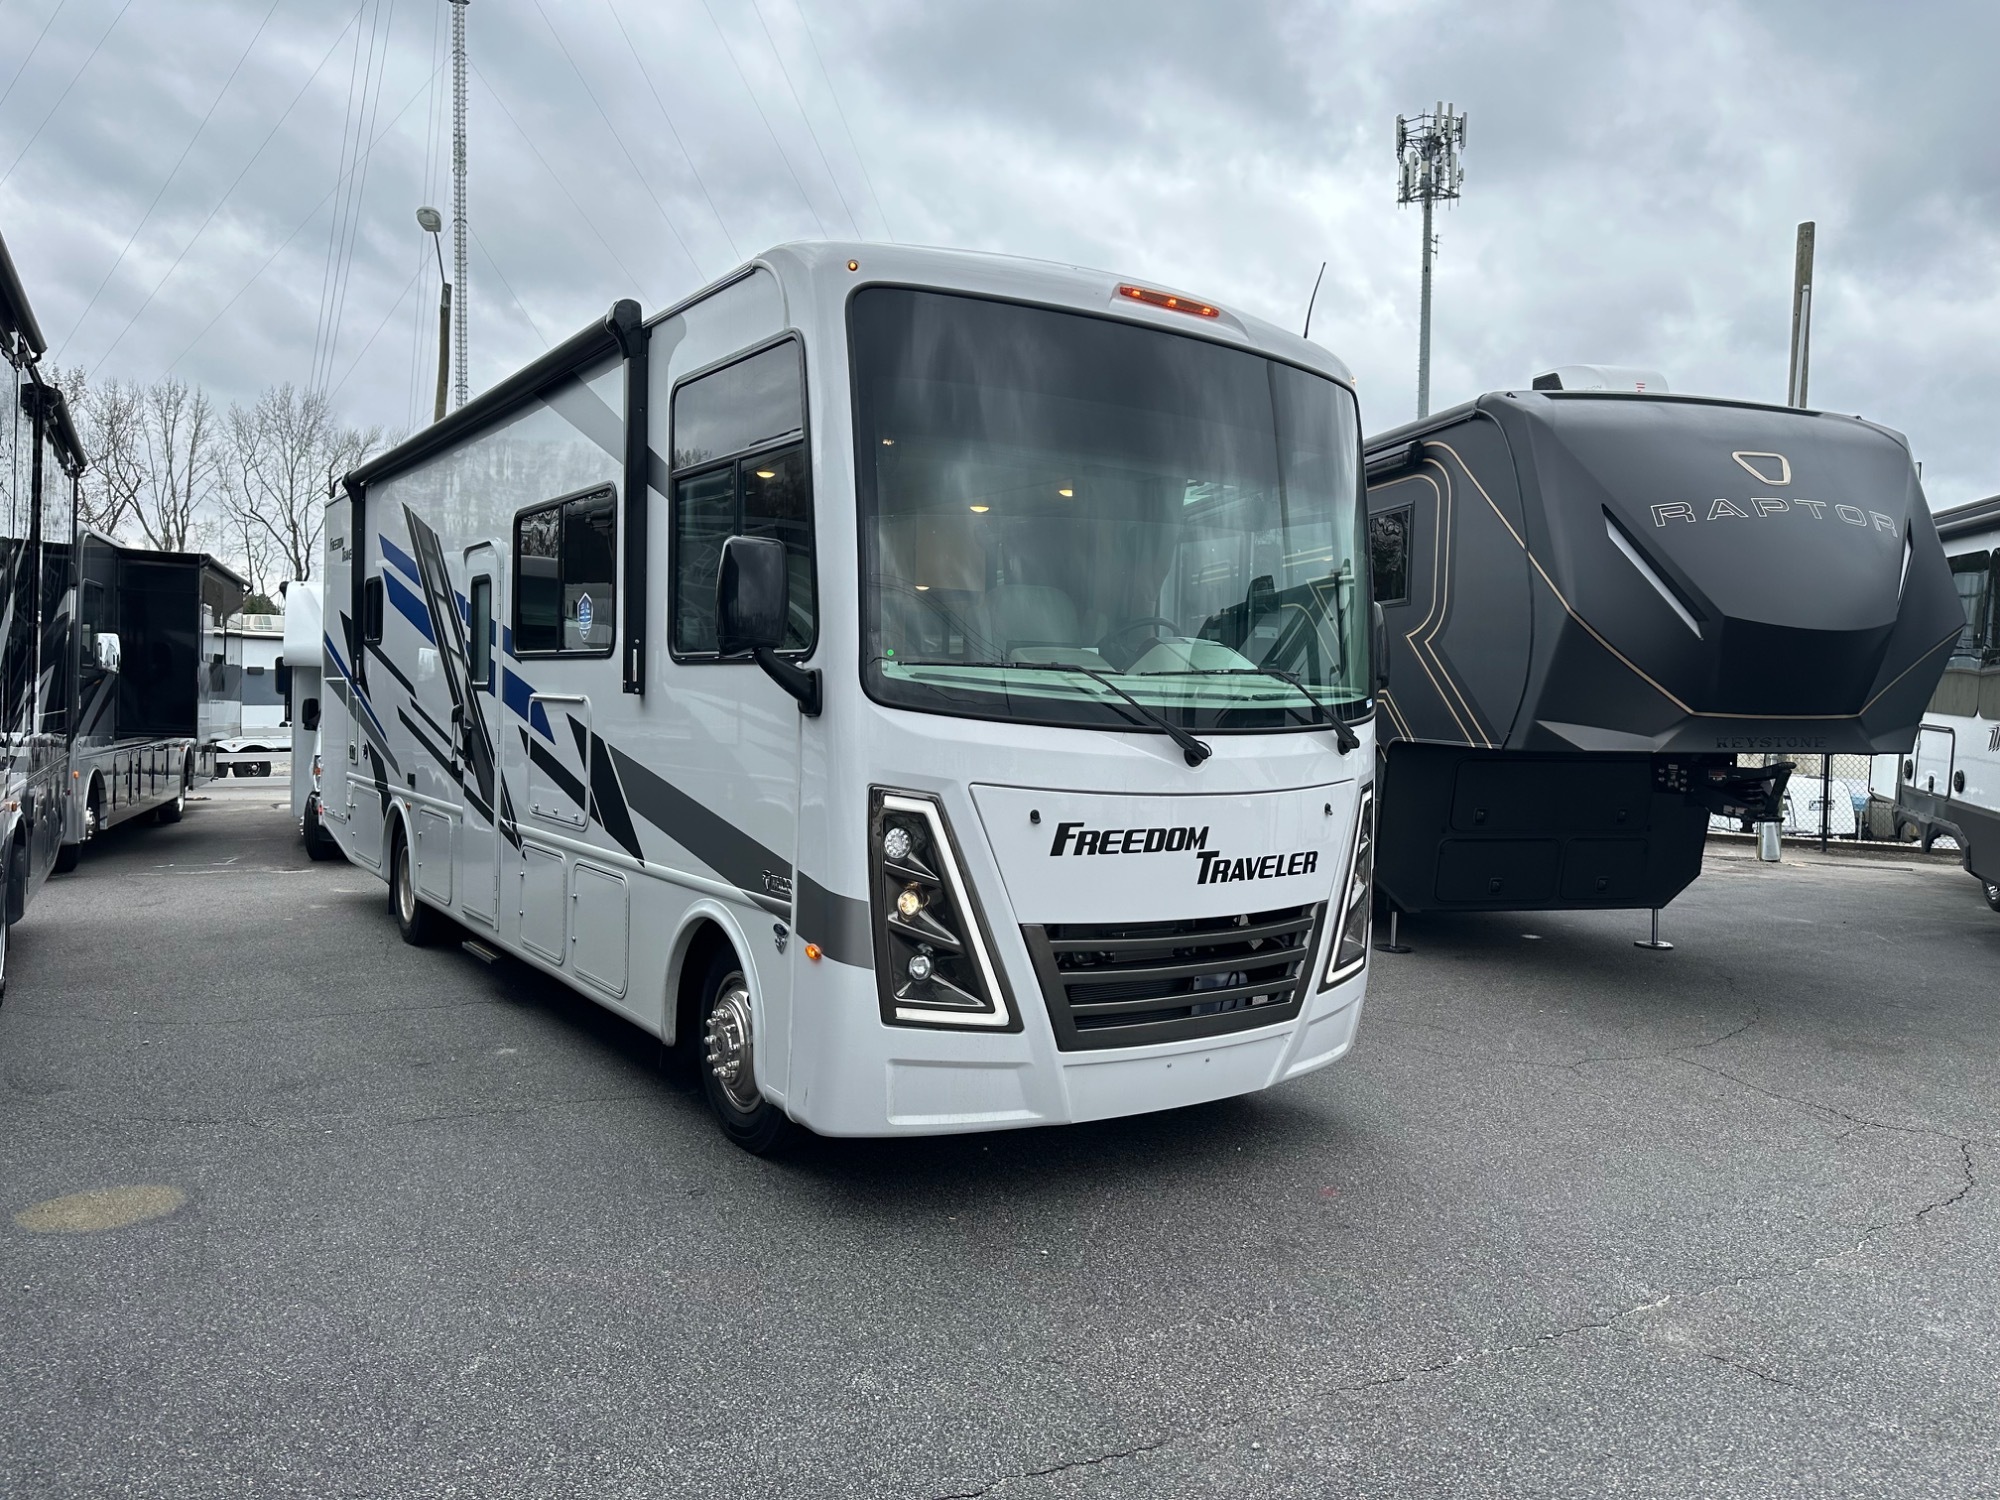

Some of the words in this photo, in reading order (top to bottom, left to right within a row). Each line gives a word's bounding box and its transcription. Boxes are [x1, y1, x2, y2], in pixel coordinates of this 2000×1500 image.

[1650, 498, 1898, 538] RAPTOR
[1715, 736, 1828, 749] KEYSTONE
[1050, 822, 1209, 857] FREEDOM
[1196, 850, 1319, 885] TRAVELER
